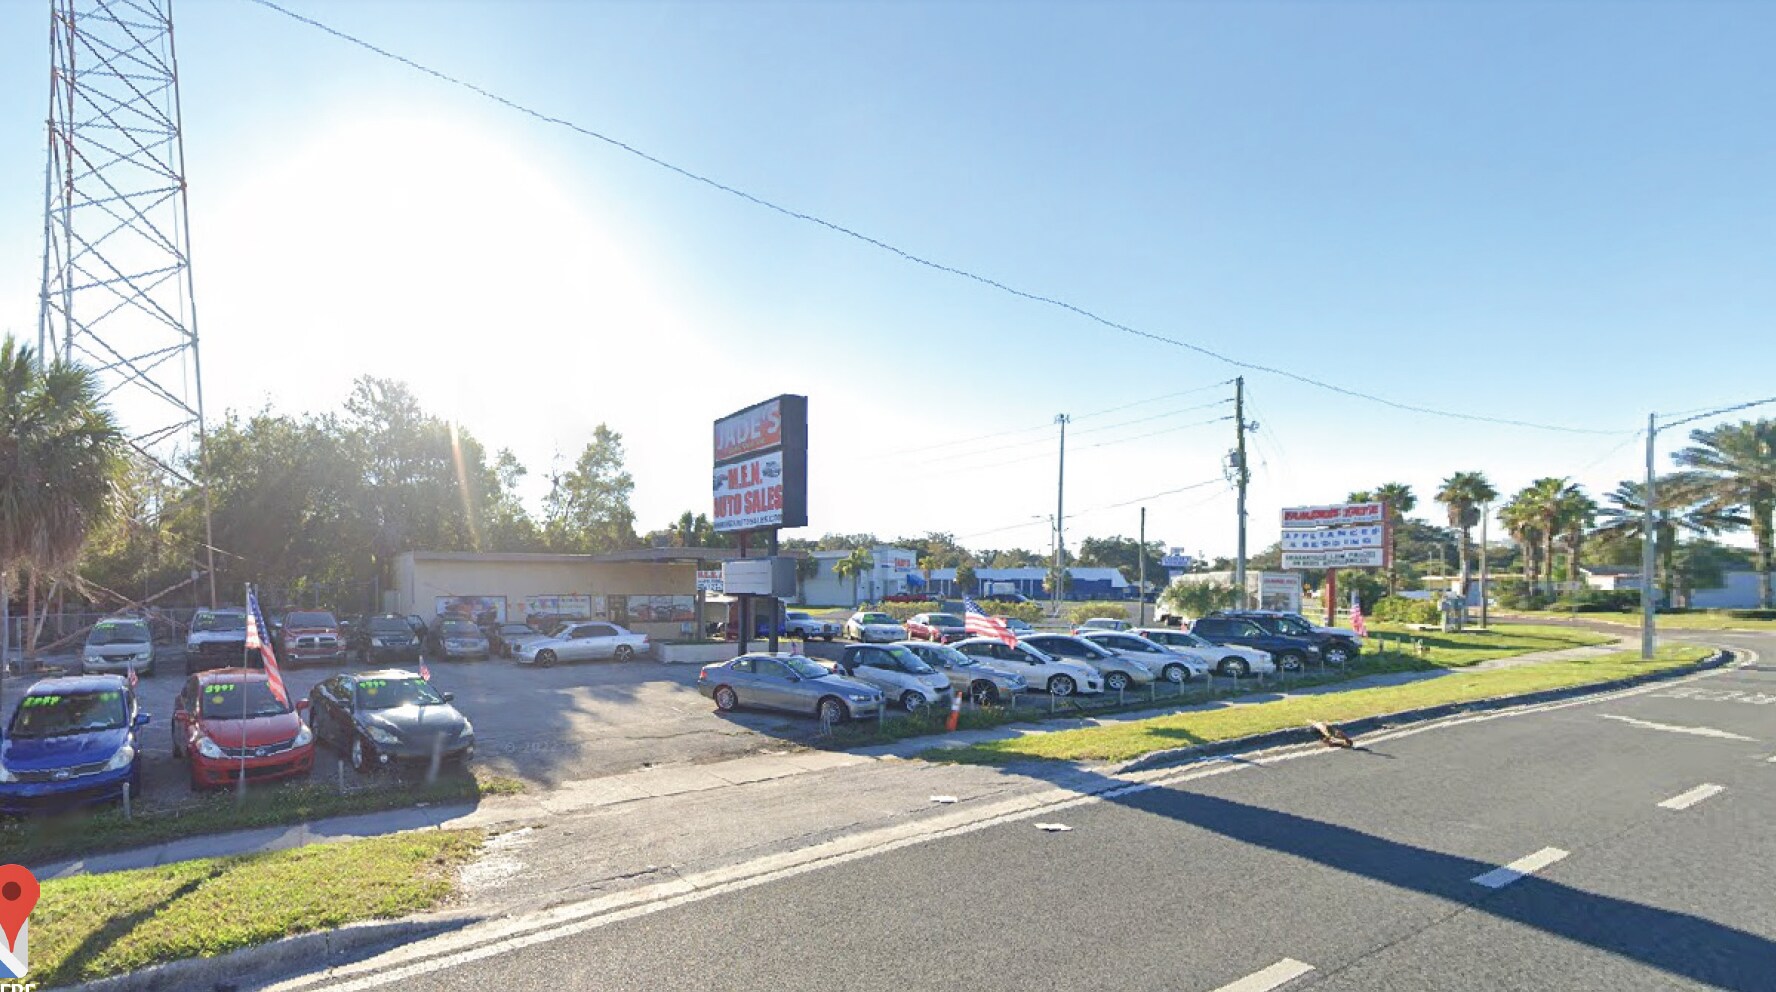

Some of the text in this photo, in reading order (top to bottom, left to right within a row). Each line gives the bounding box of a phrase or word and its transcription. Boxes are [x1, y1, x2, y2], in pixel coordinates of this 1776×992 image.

[716, 405, 781, 449] JADE'S
[714, 485, 782, 518] AUTO SALES
